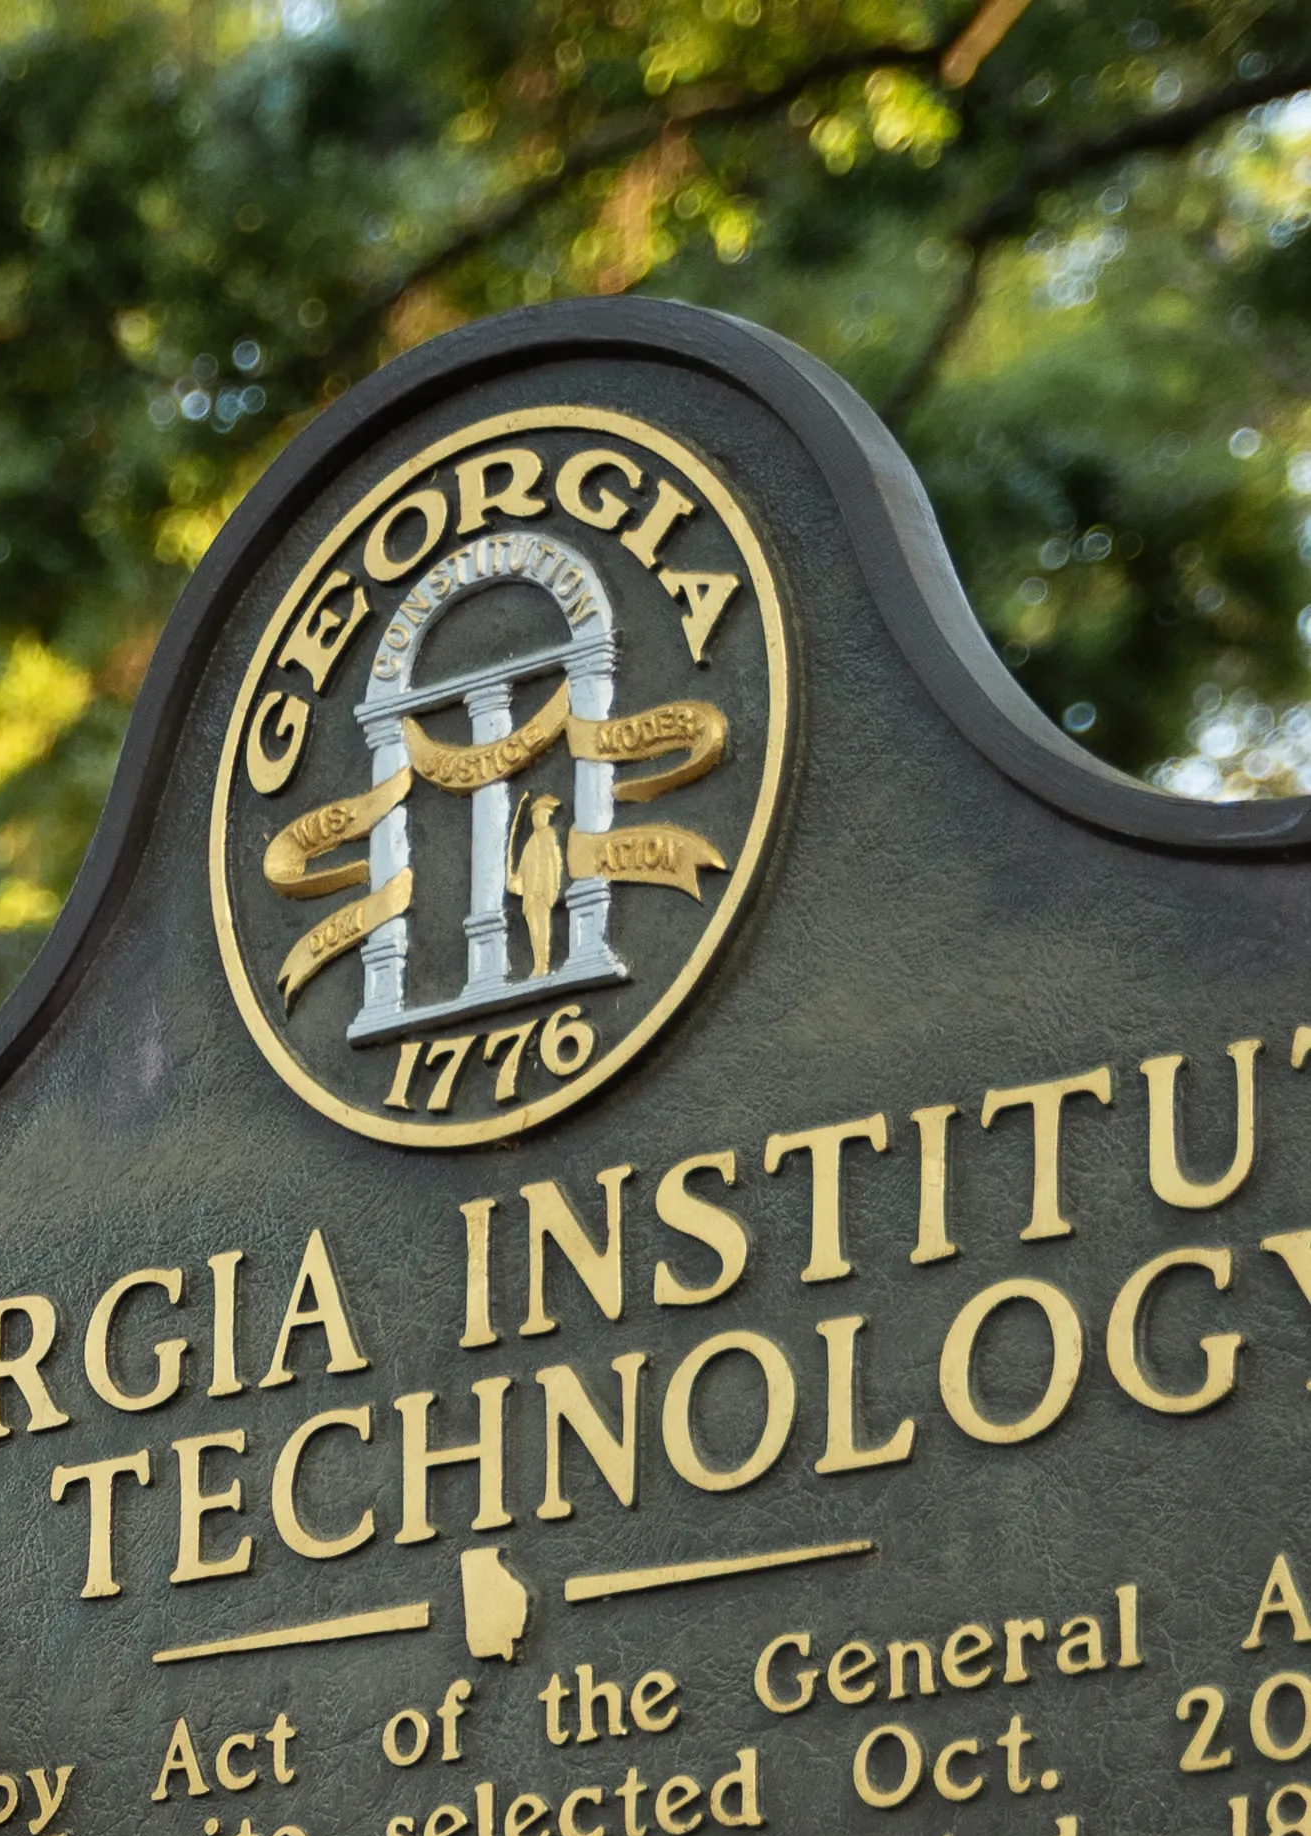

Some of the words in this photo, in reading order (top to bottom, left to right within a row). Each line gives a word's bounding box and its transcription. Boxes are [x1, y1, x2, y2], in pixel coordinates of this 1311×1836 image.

[246, 448, 744, 797] GEORGIA
[374, 535, 598, 680] CONSTITUTION
[421, 725, 546, 781] JUSTICE
[597, 835, 680, 874] ATION
[308, 908, 363, 954] DOM
[384, 1004, 597, 1112] 1776
[457, 1025, 1311, 1349] INSTITU
[149, 1711, 298, 1802] Act
[381, 1677, 473, 1767] of
[536, 1662, 680, 1746] the
[753, 1582, 1143, 1715] General
[852, 1712, 1060, 1809] Oct.
